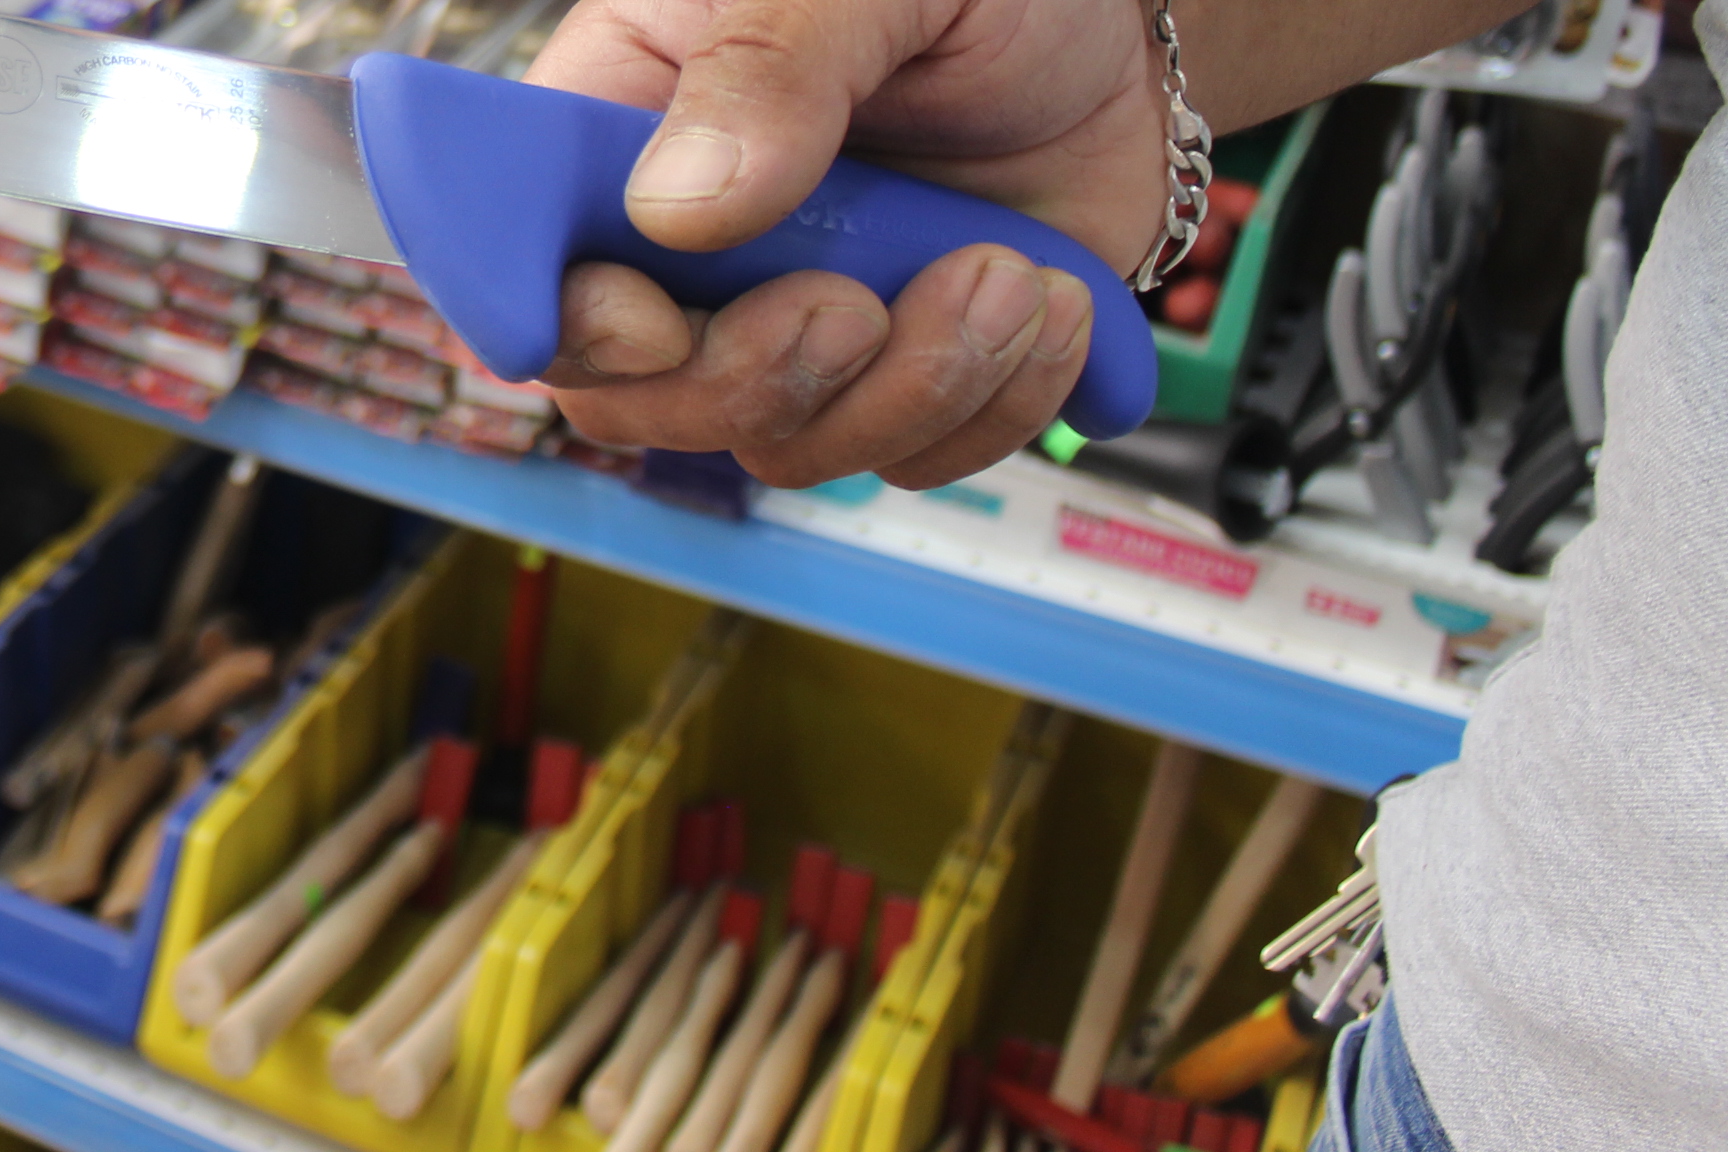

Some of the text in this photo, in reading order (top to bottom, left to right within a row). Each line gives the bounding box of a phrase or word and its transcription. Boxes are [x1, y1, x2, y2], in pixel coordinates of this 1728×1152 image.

[74, 57, 101, 76] HIGH
[102, 55, 151, 67] CARBON
[174, 71, 203, 98] STAIN
